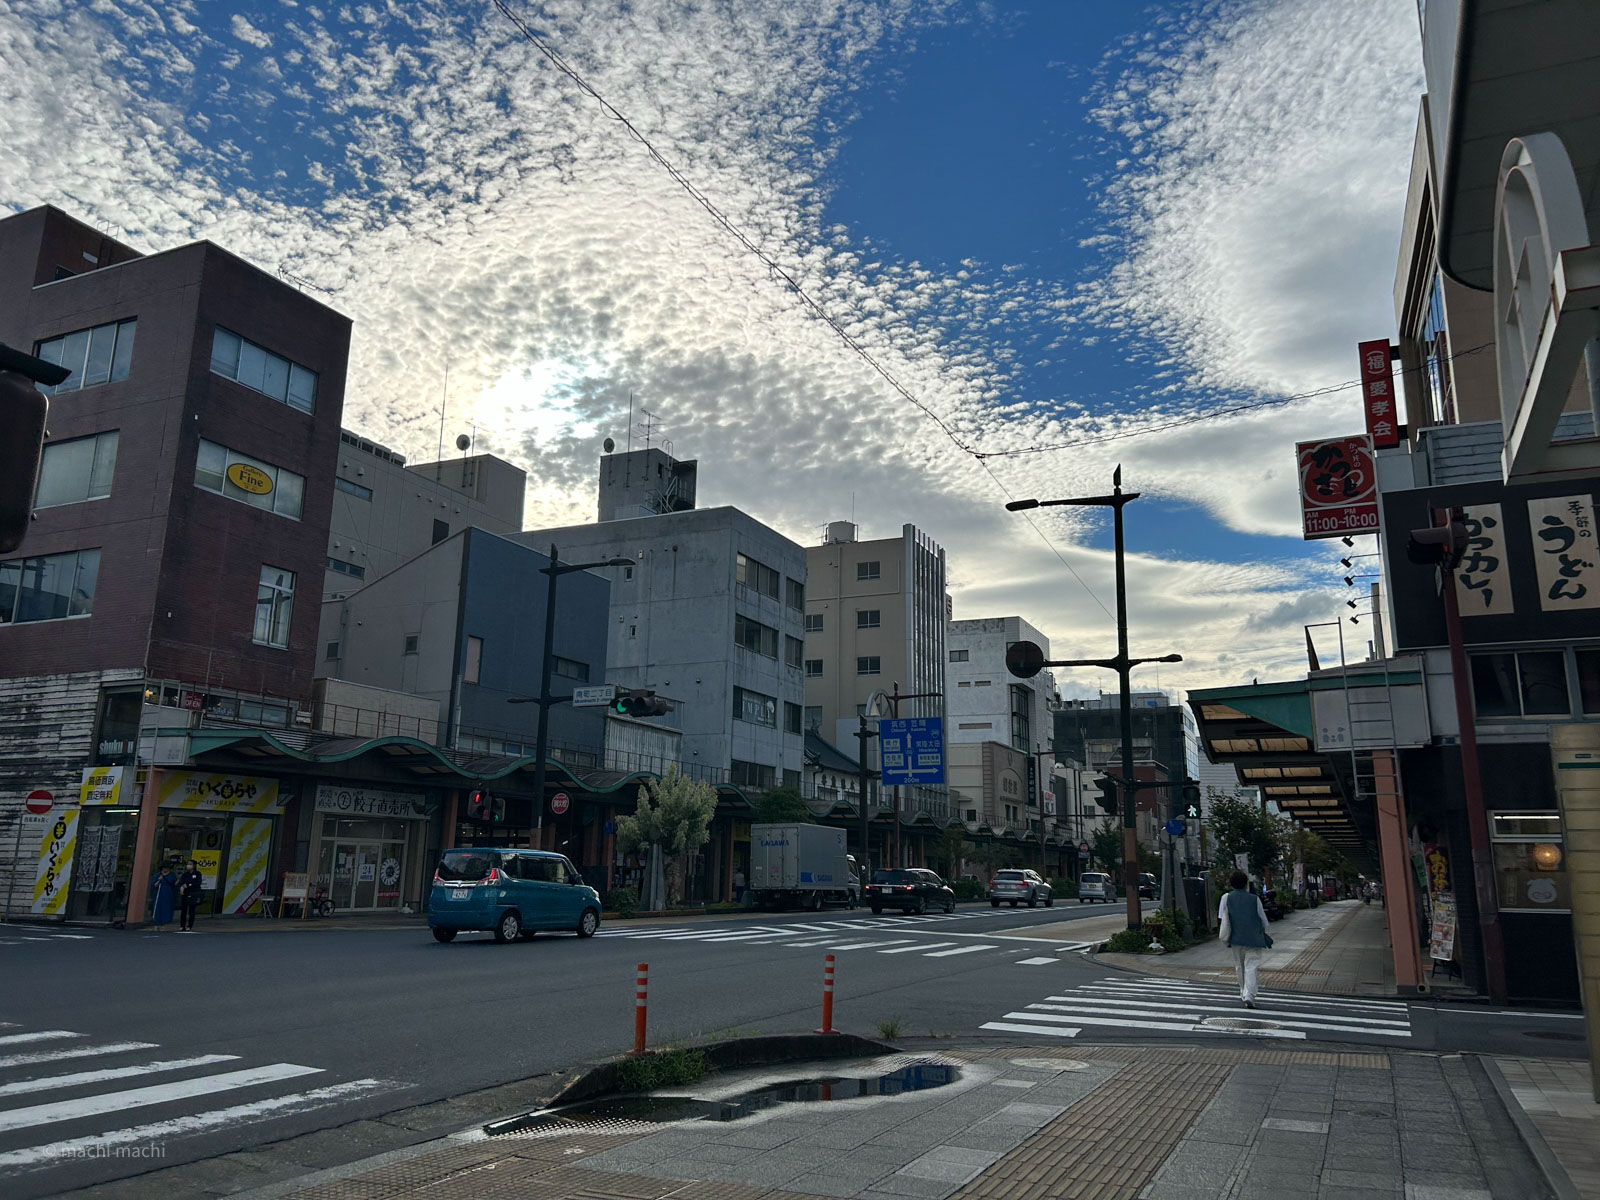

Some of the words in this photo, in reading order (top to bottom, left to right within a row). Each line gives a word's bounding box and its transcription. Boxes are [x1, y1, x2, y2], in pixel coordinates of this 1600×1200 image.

[1349, 442, 1361, 467] かつ丼の
[239, 470, 264, 487] Fine
[1343, 507, 1357, 515] PM
[1568, 500, 1592, 538] 季節の
[1538, 515, 1594, 600] うどん
[87, 791, 113, 801] 査定無料
[760, 839, 790, 847] SAGAWA
[44, 841, 60, 896] いくらや
